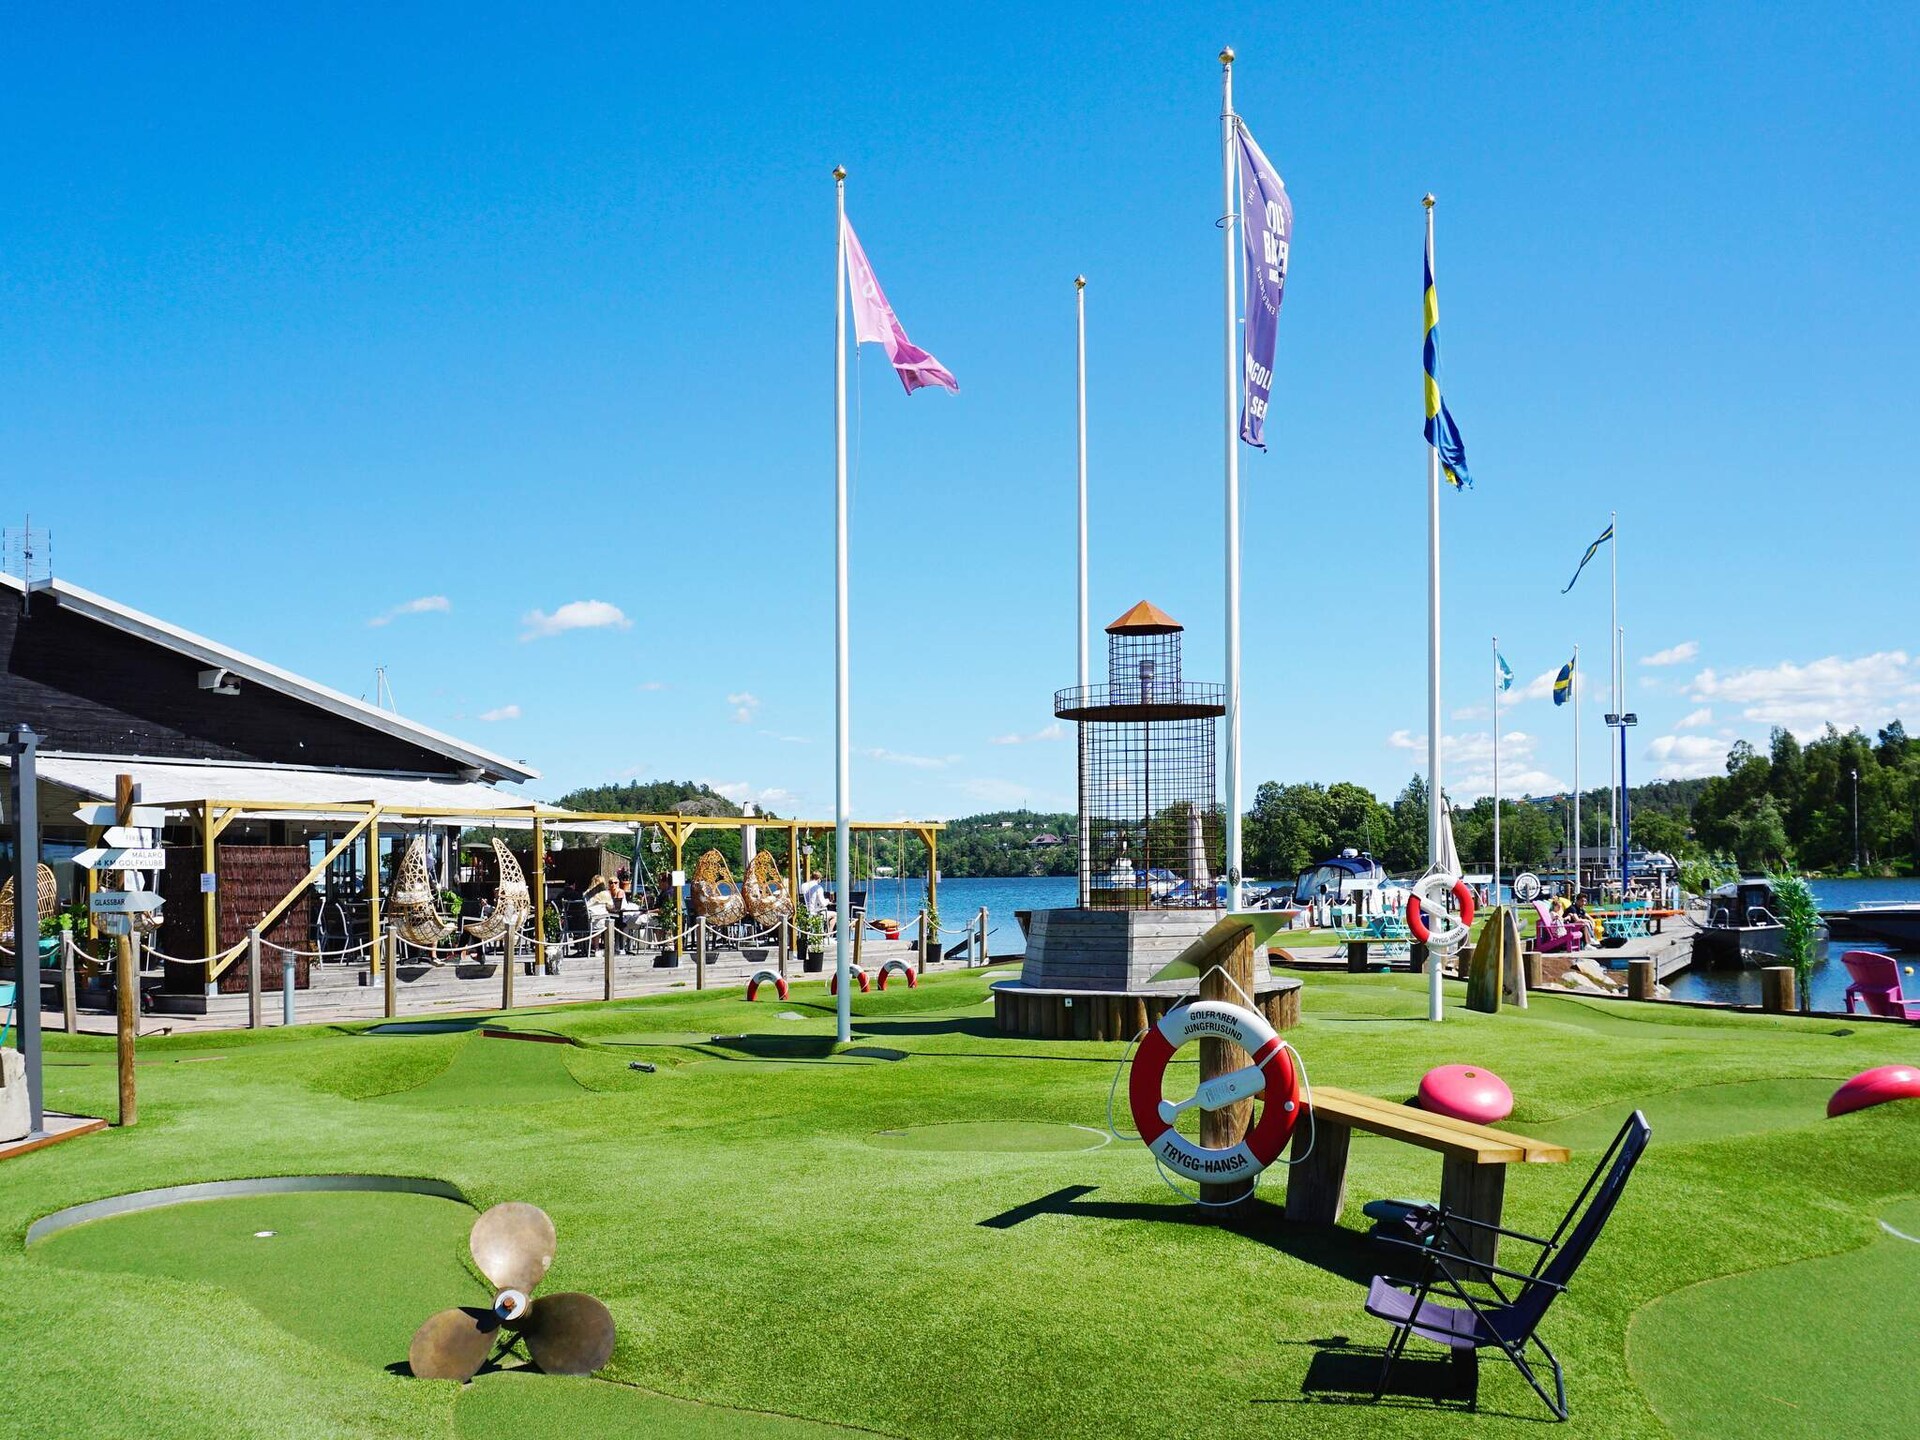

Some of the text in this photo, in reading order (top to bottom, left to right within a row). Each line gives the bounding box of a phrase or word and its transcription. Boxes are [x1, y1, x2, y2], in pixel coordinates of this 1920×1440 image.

[118, 859, 164, 867] GOLFKLUBB
[94, 898, 125, 906] GLASSBAR
[1184, 1022, 1243, 1041] JUNGFRUSUND
[1162, 1141, 1248, 1174] TRYGG-HANSA
